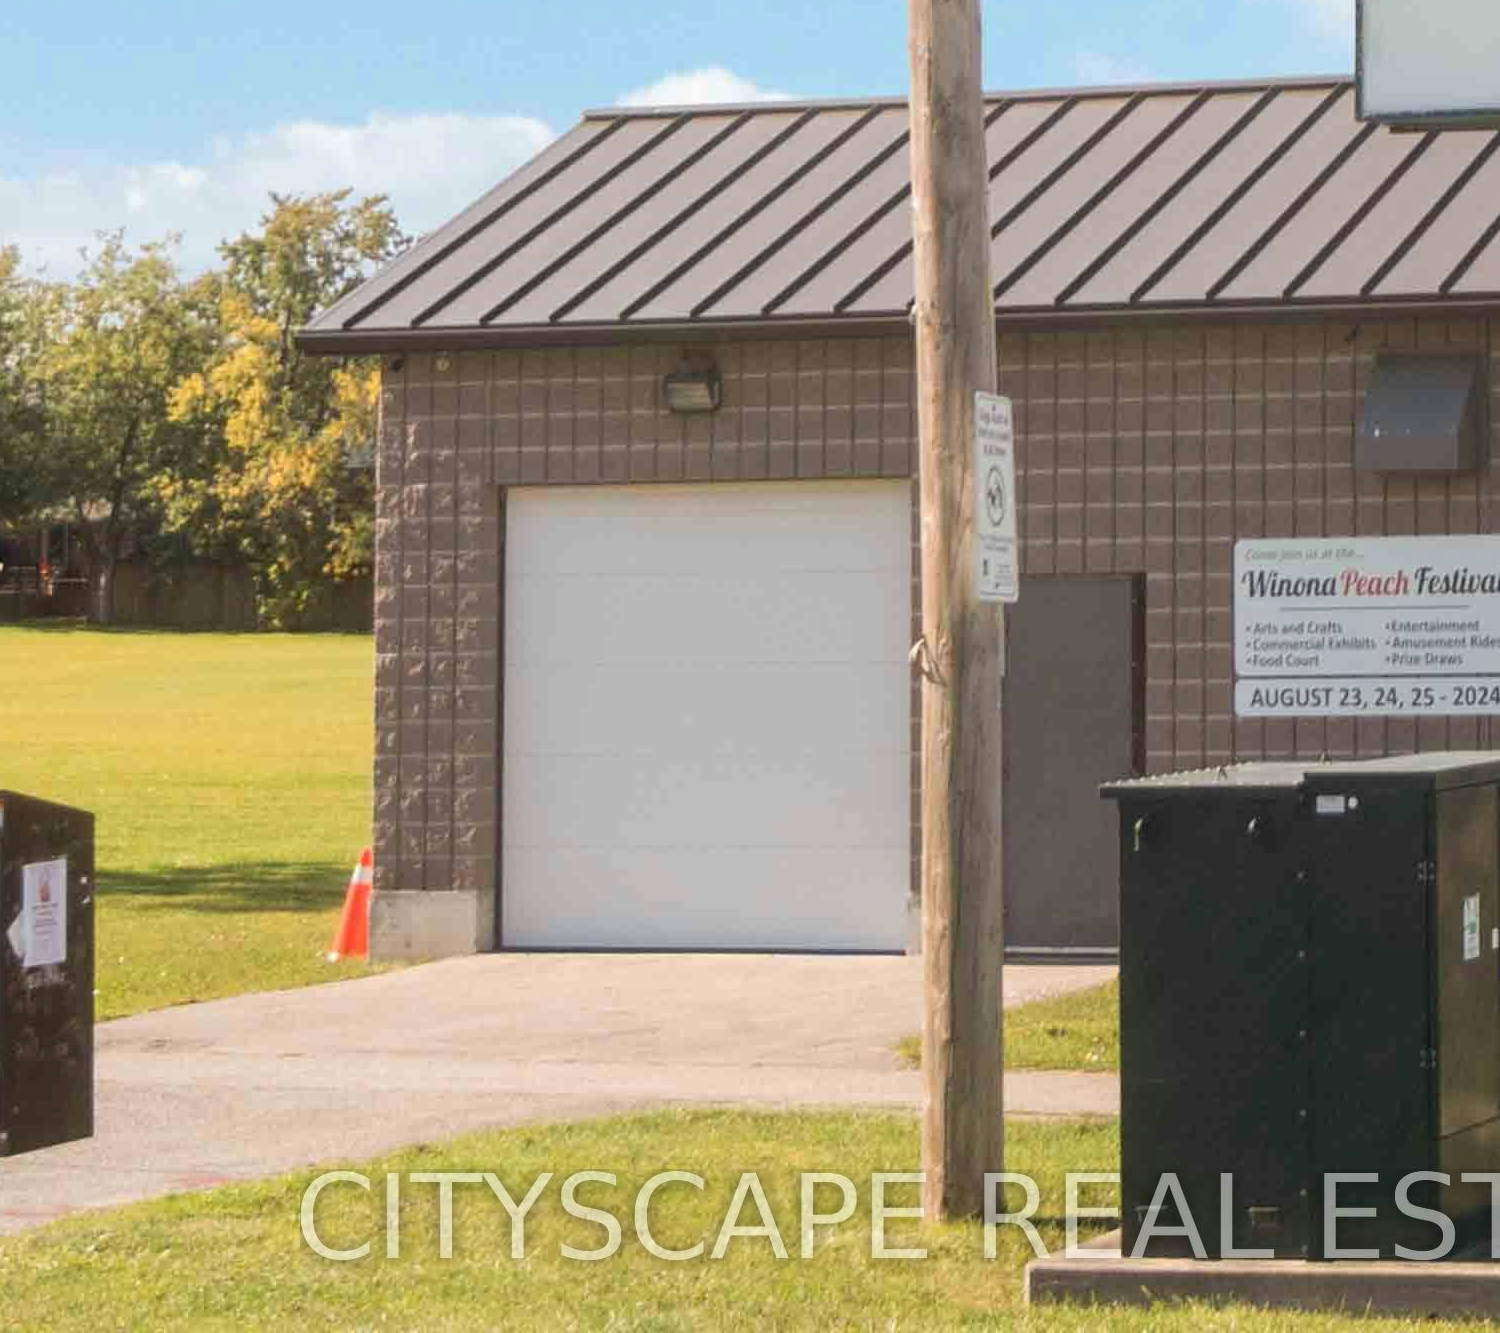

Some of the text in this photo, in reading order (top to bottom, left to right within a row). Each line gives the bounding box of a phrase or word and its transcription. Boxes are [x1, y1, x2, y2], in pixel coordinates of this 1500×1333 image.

[1241, 570, 1337, 597] Winona
[1341, 566, 1409, 597] Peach
[1251, 687, 1333, 708] AUGUST
[1339, 687, 1367, 710] 23,
[1375, 687, 1403, 709] 24,
[1411, 686, 1435, 707] 25
